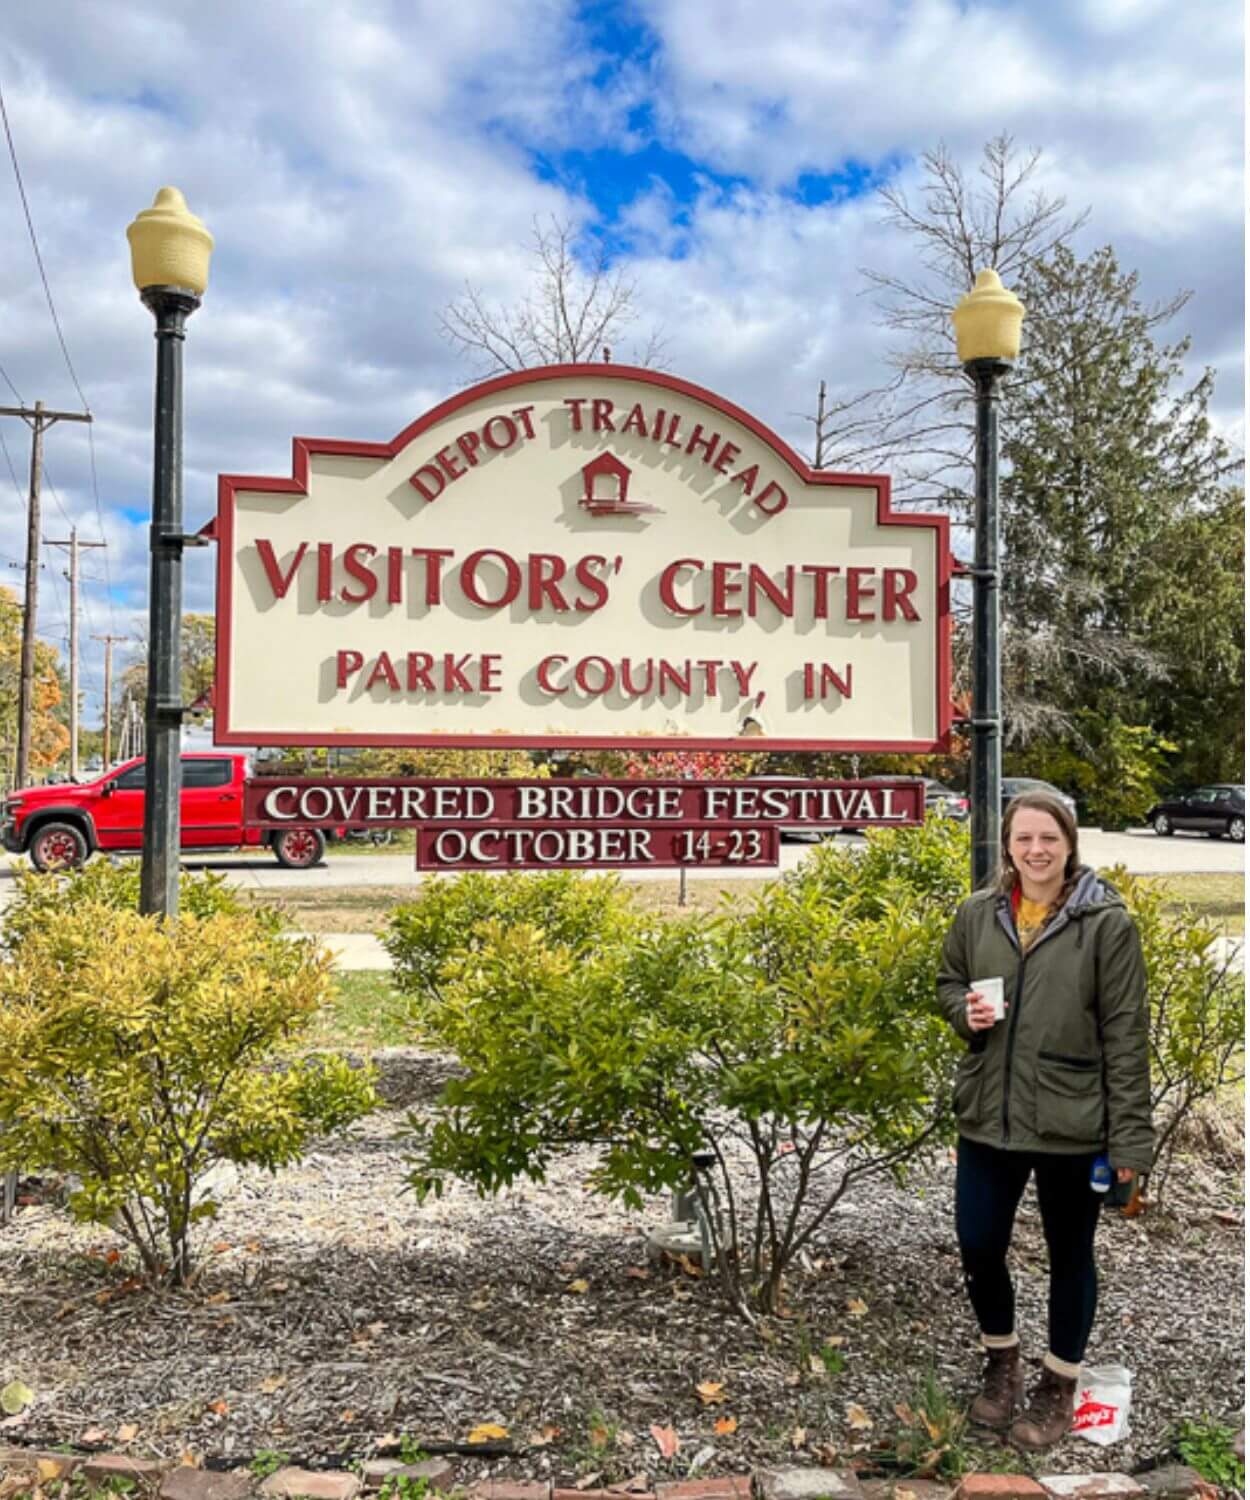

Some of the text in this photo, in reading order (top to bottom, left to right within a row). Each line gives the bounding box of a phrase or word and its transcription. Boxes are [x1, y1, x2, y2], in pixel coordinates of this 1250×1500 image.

[409, 399, 790, 517] DEPOT TRAILHEAD
[255, 539, 921, 623] VISITORS' CENTER
[336, 650, 853, 708] PARKE COUNTY, IN
[264, 786, 908, 821] COVERED BRIDGE FESTIVAL
[436, 828, 763, 862] OCTOBER 14-23
